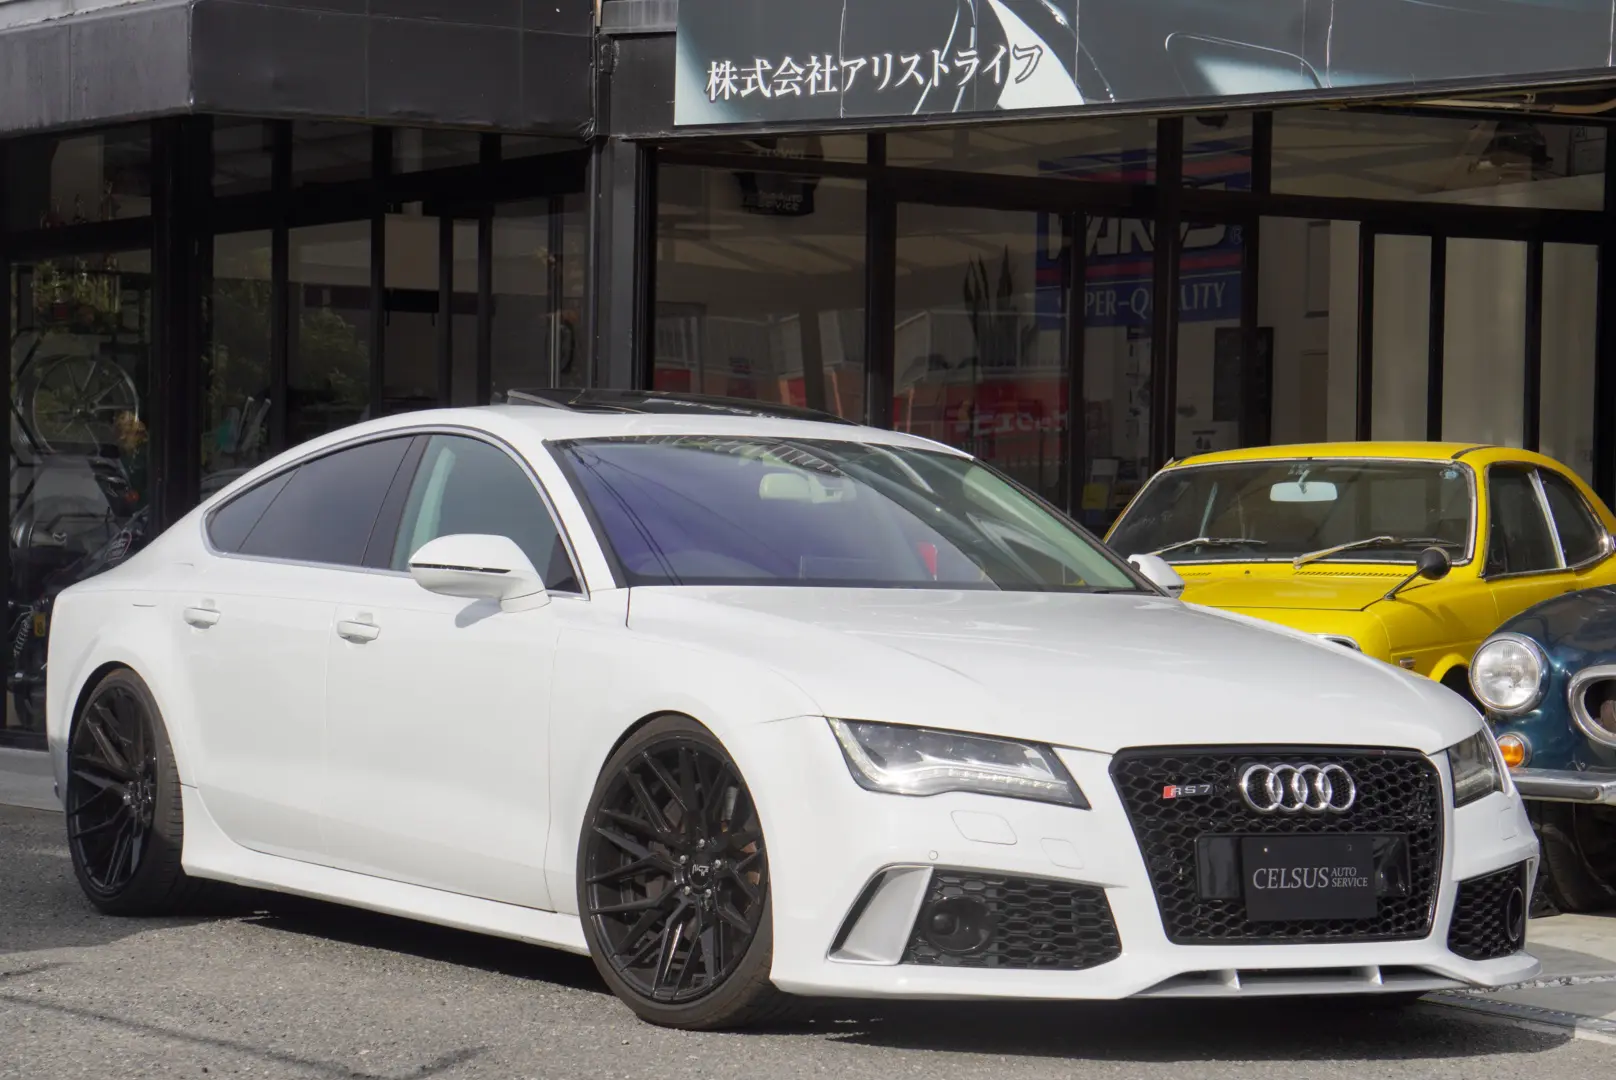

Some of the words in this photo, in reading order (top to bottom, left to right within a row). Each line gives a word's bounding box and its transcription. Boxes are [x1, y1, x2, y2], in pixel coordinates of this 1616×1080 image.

[703, 44, 1044, 102] 株式会社アリストライフ
[1170, 784, 1210, 796] RS7
[1253, 867, 1329, 889] CELSUS
[1330, 866, 1358, 878] AUTO
[1331, 876, 1369, 888] SERVICE
